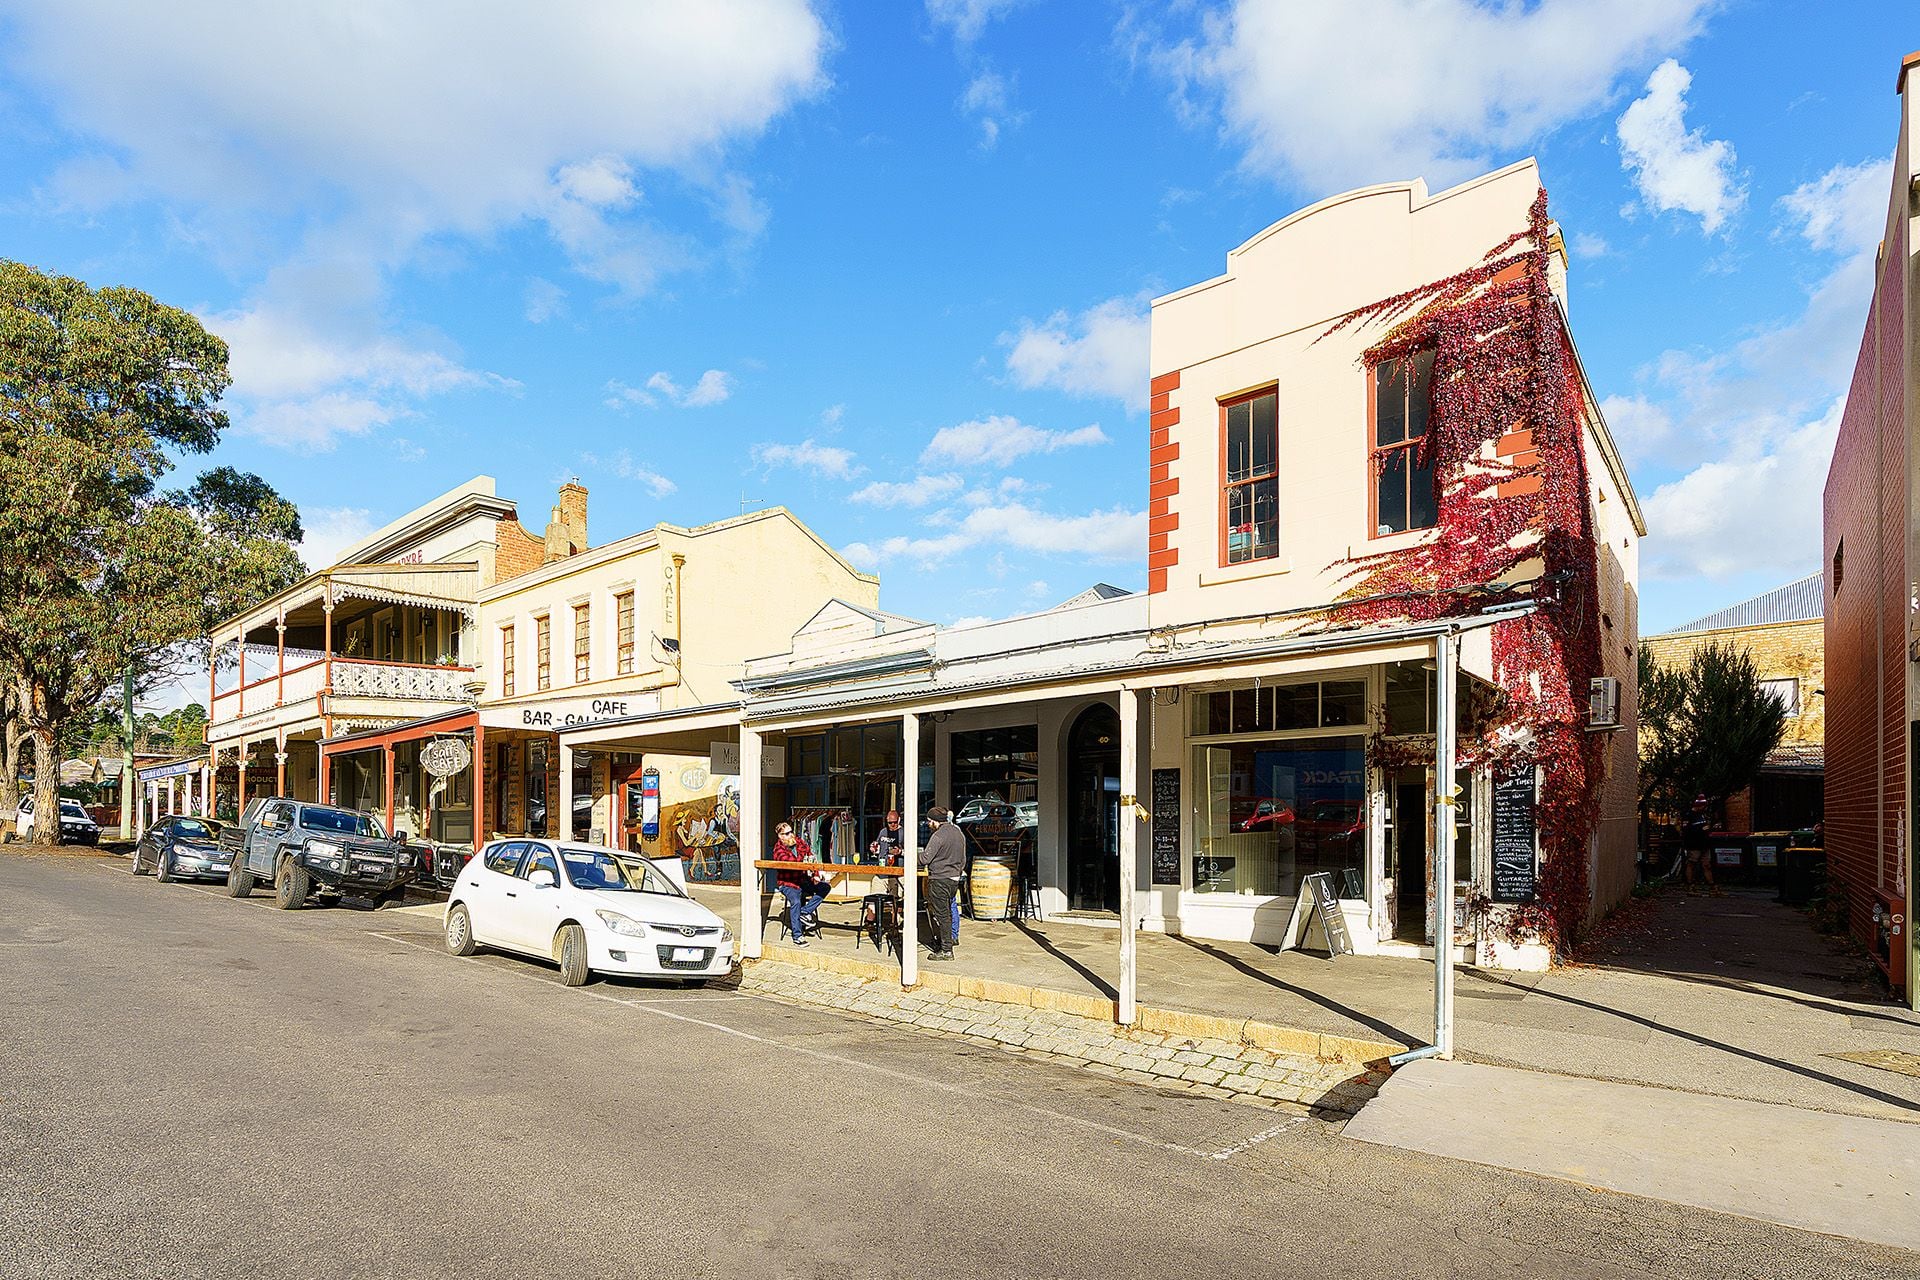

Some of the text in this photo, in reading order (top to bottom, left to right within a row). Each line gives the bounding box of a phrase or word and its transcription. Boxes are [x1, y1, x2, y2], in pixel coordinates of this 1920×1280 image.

[664, 566, 674, 624] CAFE
[592, 700, 628, 715] CAFE
[523, 710, 552, 725] BAR
[433, 758, 463, 769] CAFE
